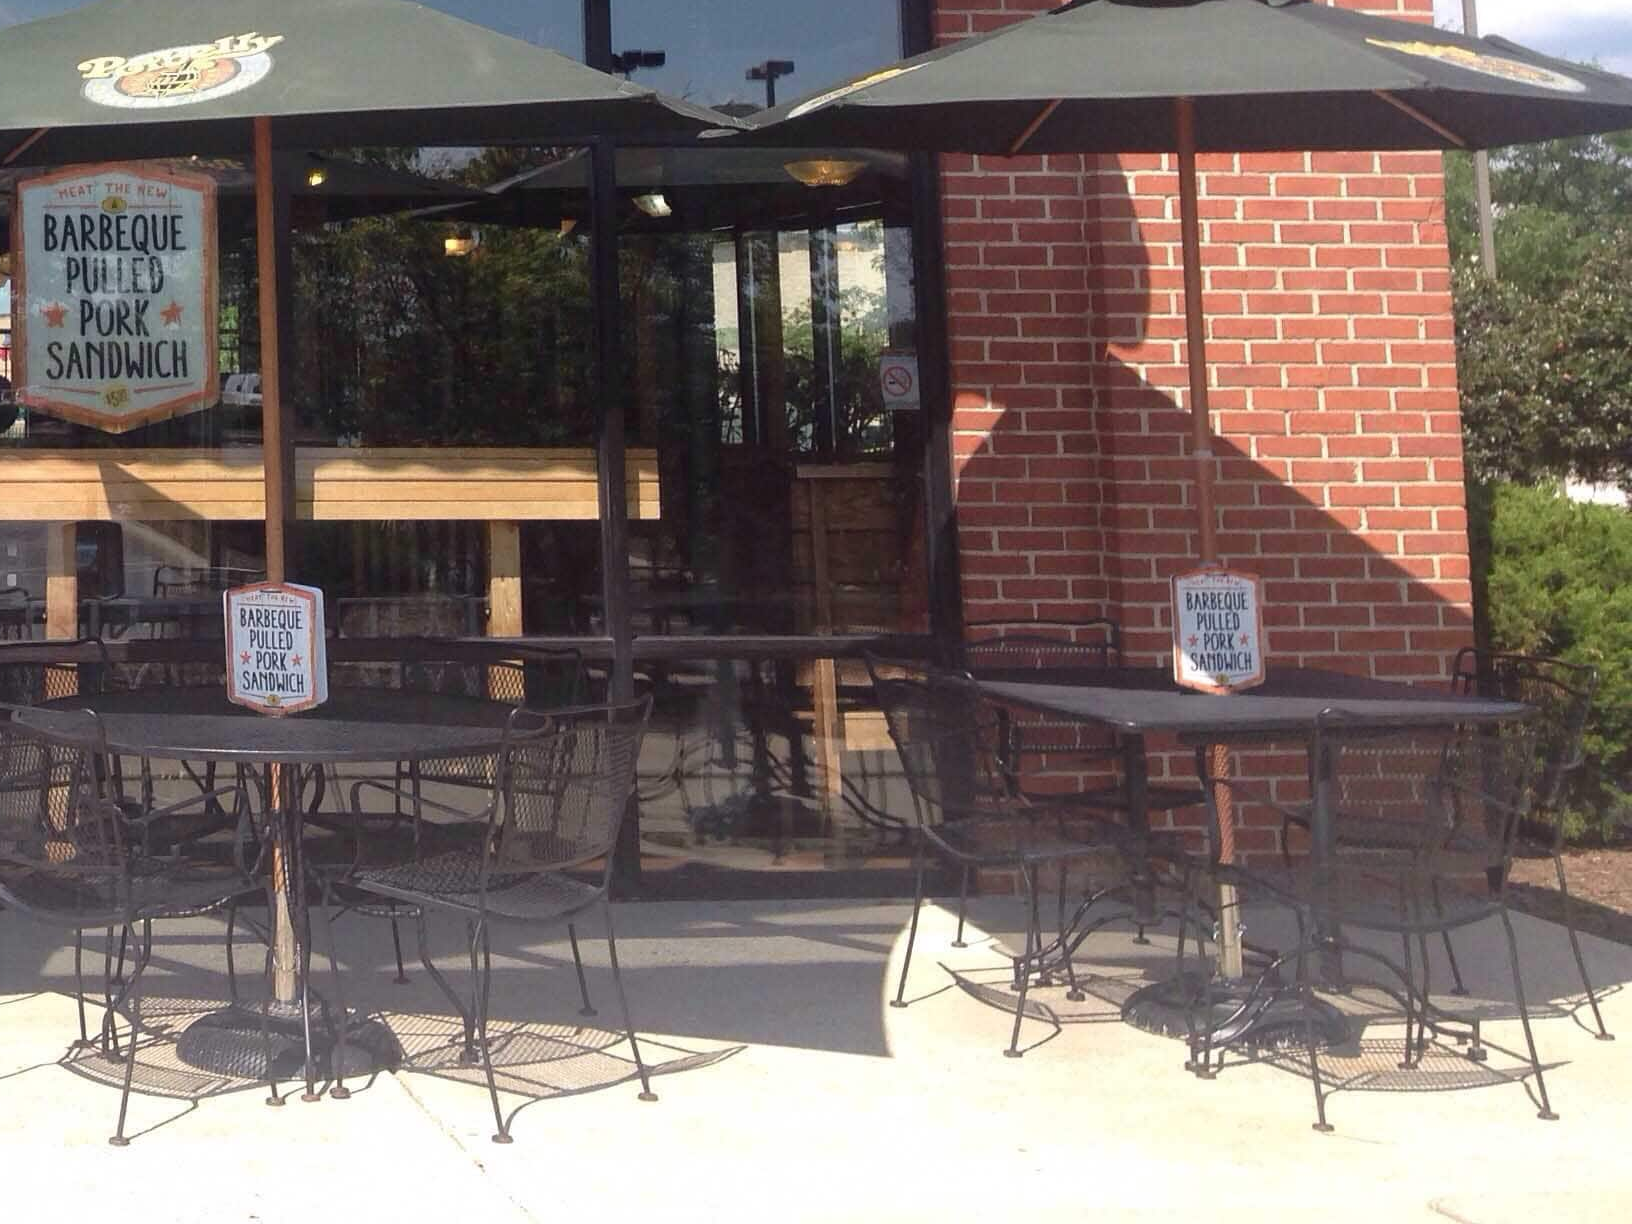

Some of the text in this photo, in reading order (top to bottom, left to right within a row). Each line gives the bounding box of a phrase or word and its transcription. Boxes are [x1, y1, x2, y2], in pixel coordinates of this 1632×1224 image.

[105, 182, 130, 194] THE
[138, 183, 168, 199] NEW
[44, 214, 187, 254] BARBEQUE
[67, 256, 164, 294] PULLED
[80, 299, 150, 336] PORK
[46, 341, 189, 380] SANDWICH
[1186, 591, 1249, 612] BARBEQUE
[239, 607, 303, 630] BARBEQUE
[1196, 611, 1240, 632] PULLED
[249, 629, 293, 651] PULLED
[1203, 631, 1235, 652] PORK
[256, 650, 287, 672] PORK
[1190, 652, 1253, 672] SANDWICH
[242, 671, 305, 694] SANDWICH
